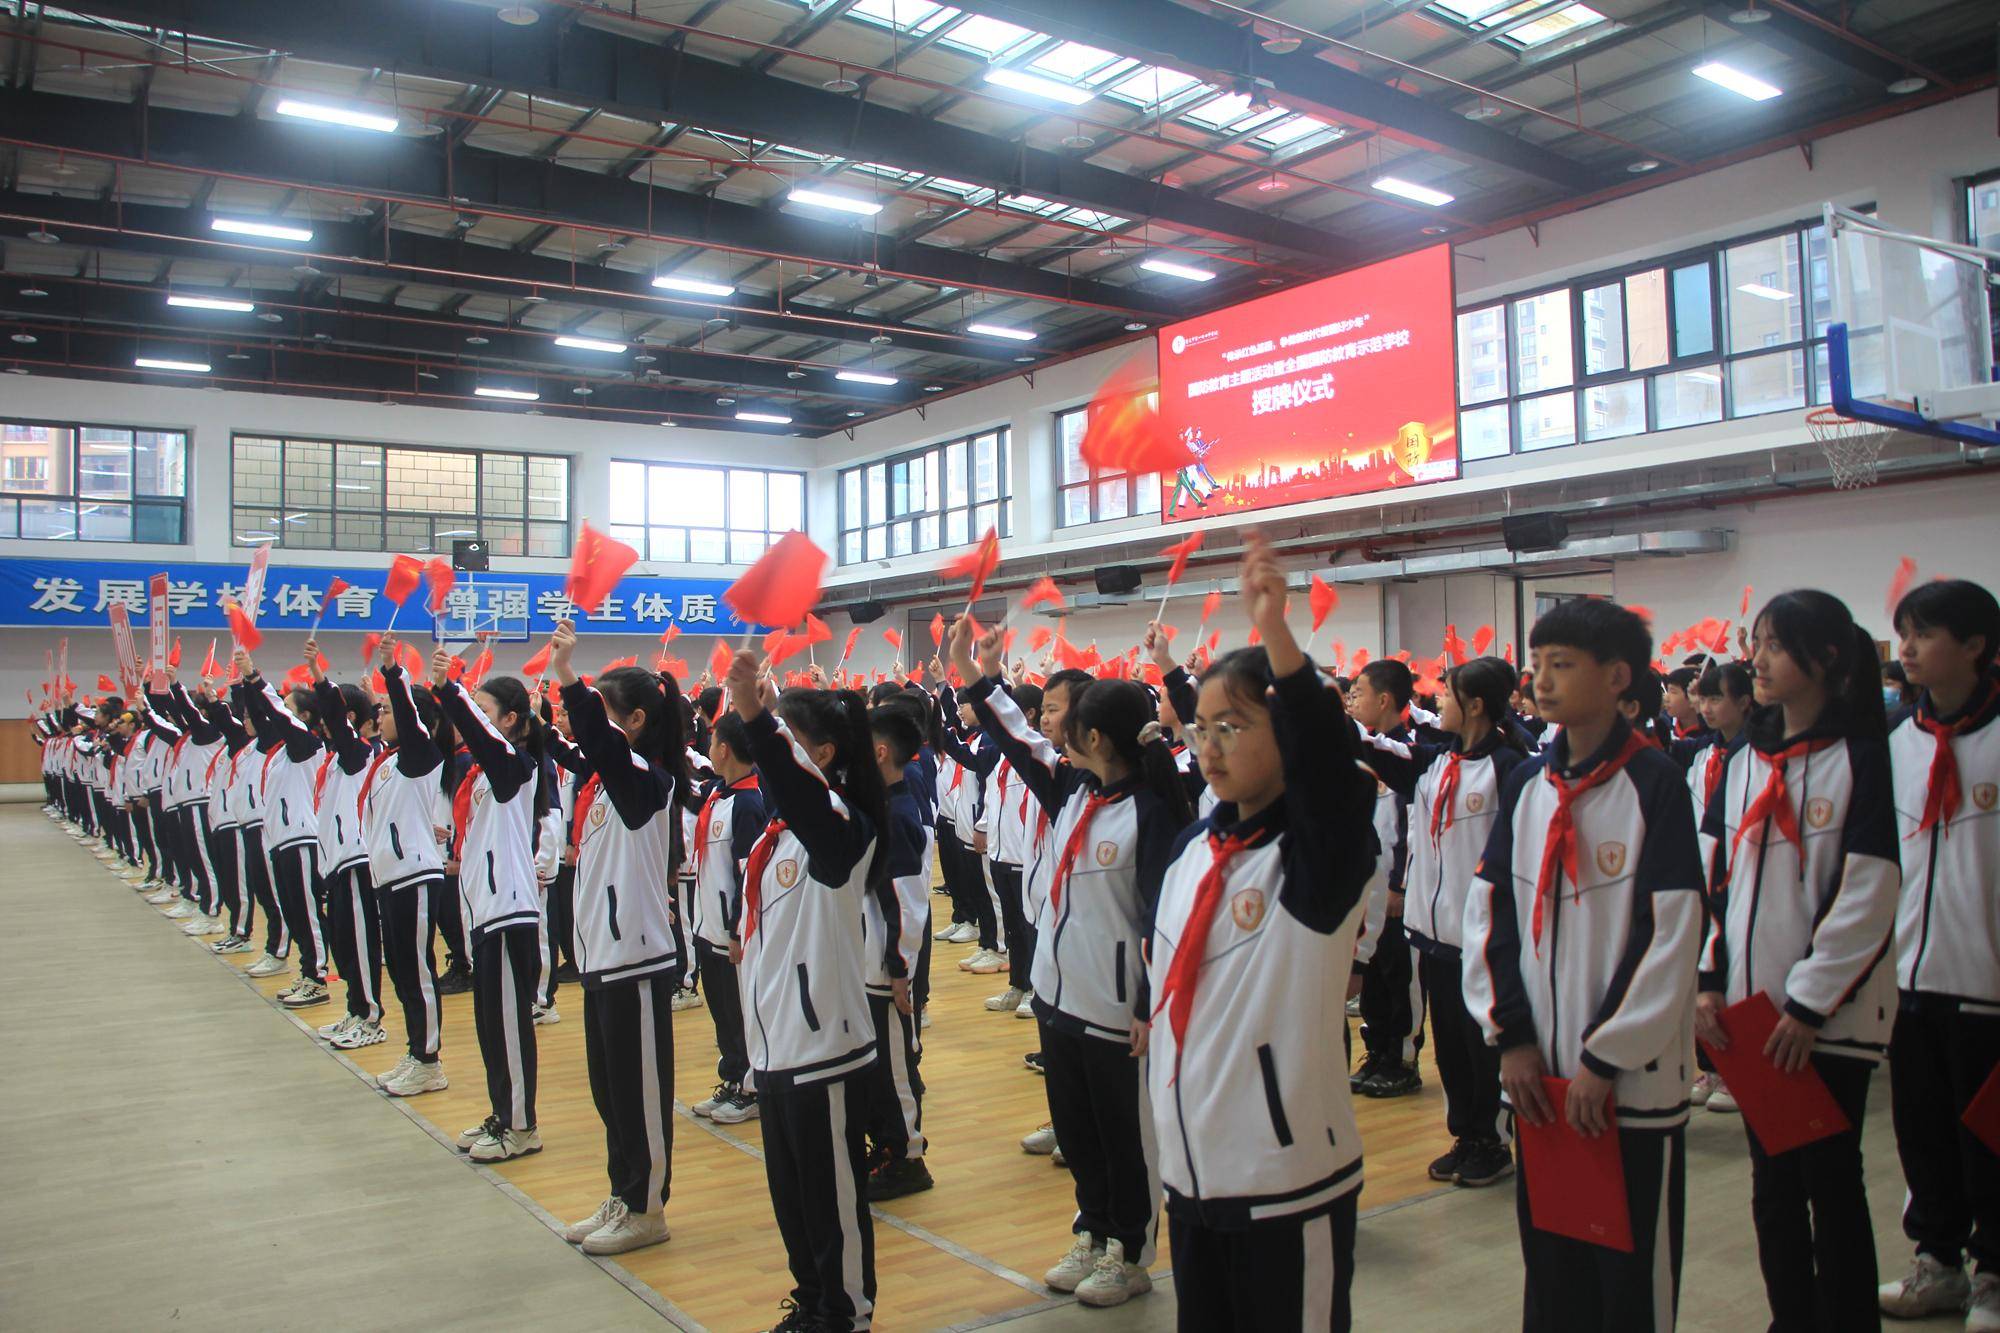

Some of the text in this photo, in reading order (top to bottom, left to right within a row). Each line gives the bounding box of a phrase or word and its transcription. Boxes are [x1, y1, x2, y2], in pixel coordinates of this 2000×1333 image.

[1252, 373, 1335, 417] 授牌仪式
[1405, 434, 1419, 466] 国防
[29, 577, 378, 618] 发展学校体育
[439, 588, 717, 623] 增强学生体质
